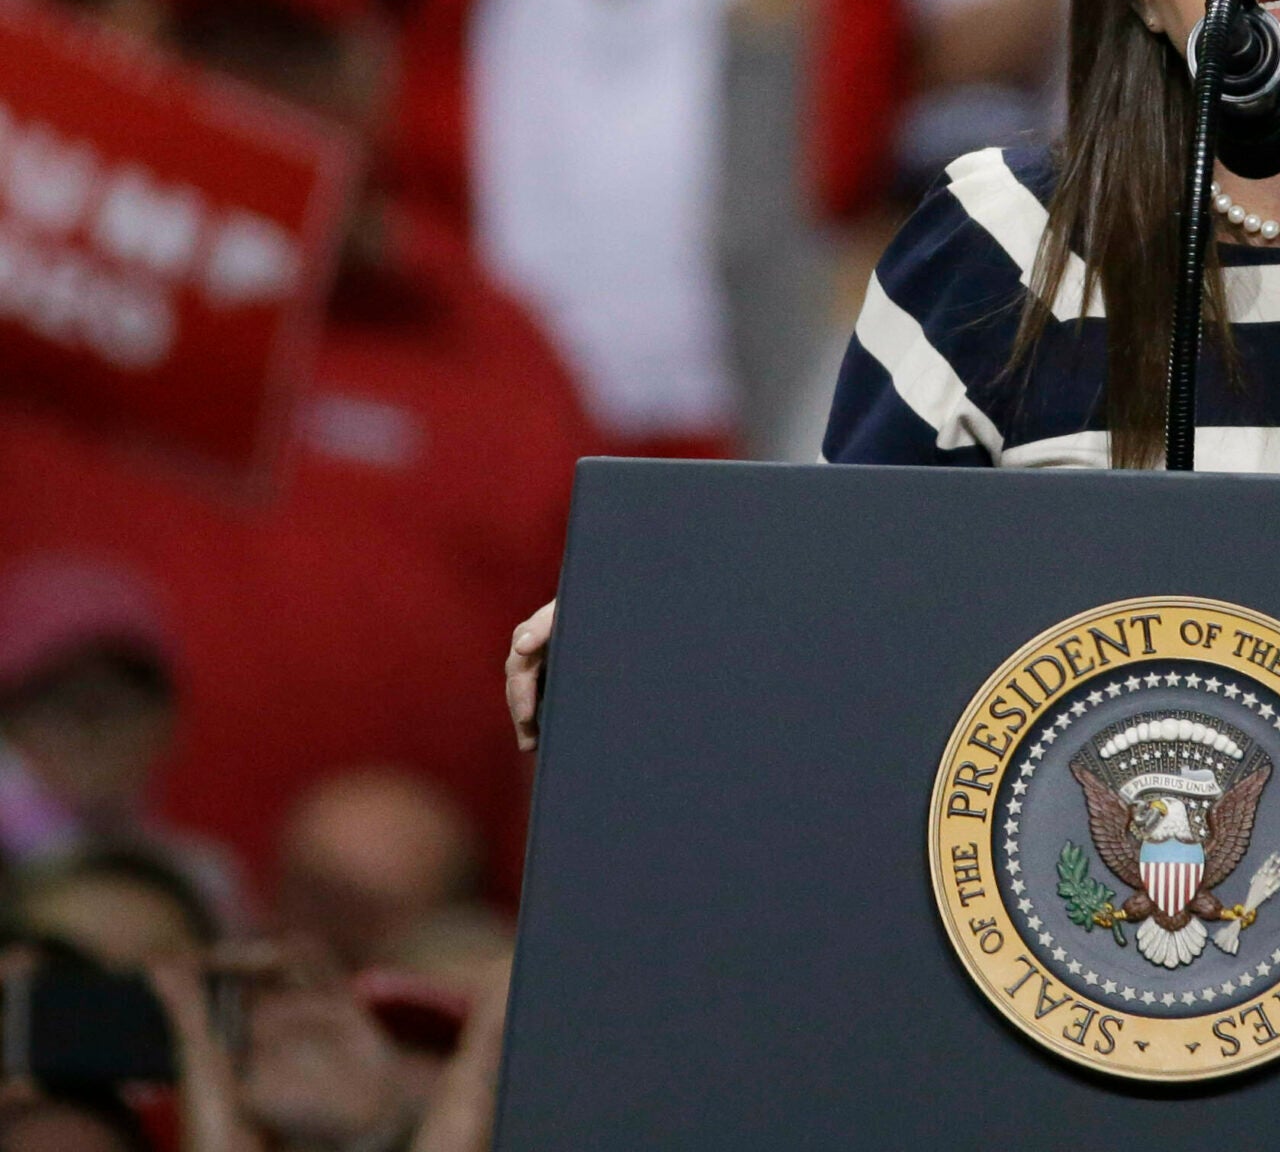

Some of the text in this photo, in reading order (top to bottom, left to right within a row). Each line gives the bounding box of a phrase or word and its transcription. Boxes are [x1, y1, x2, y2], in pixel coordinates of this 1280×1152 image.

[1180, 619, 1222, 648] OF
[947, 614, 1162, 824] PRESIDENT
[1133, 776, 1184, 791] PLURIBUS
[1186, 781, 1217, 794] UNUM
[951, 842, 985, 908] THE
[969, 916, 1005, 956] OF
[1004, 954, 1125, 1055] SEAL
